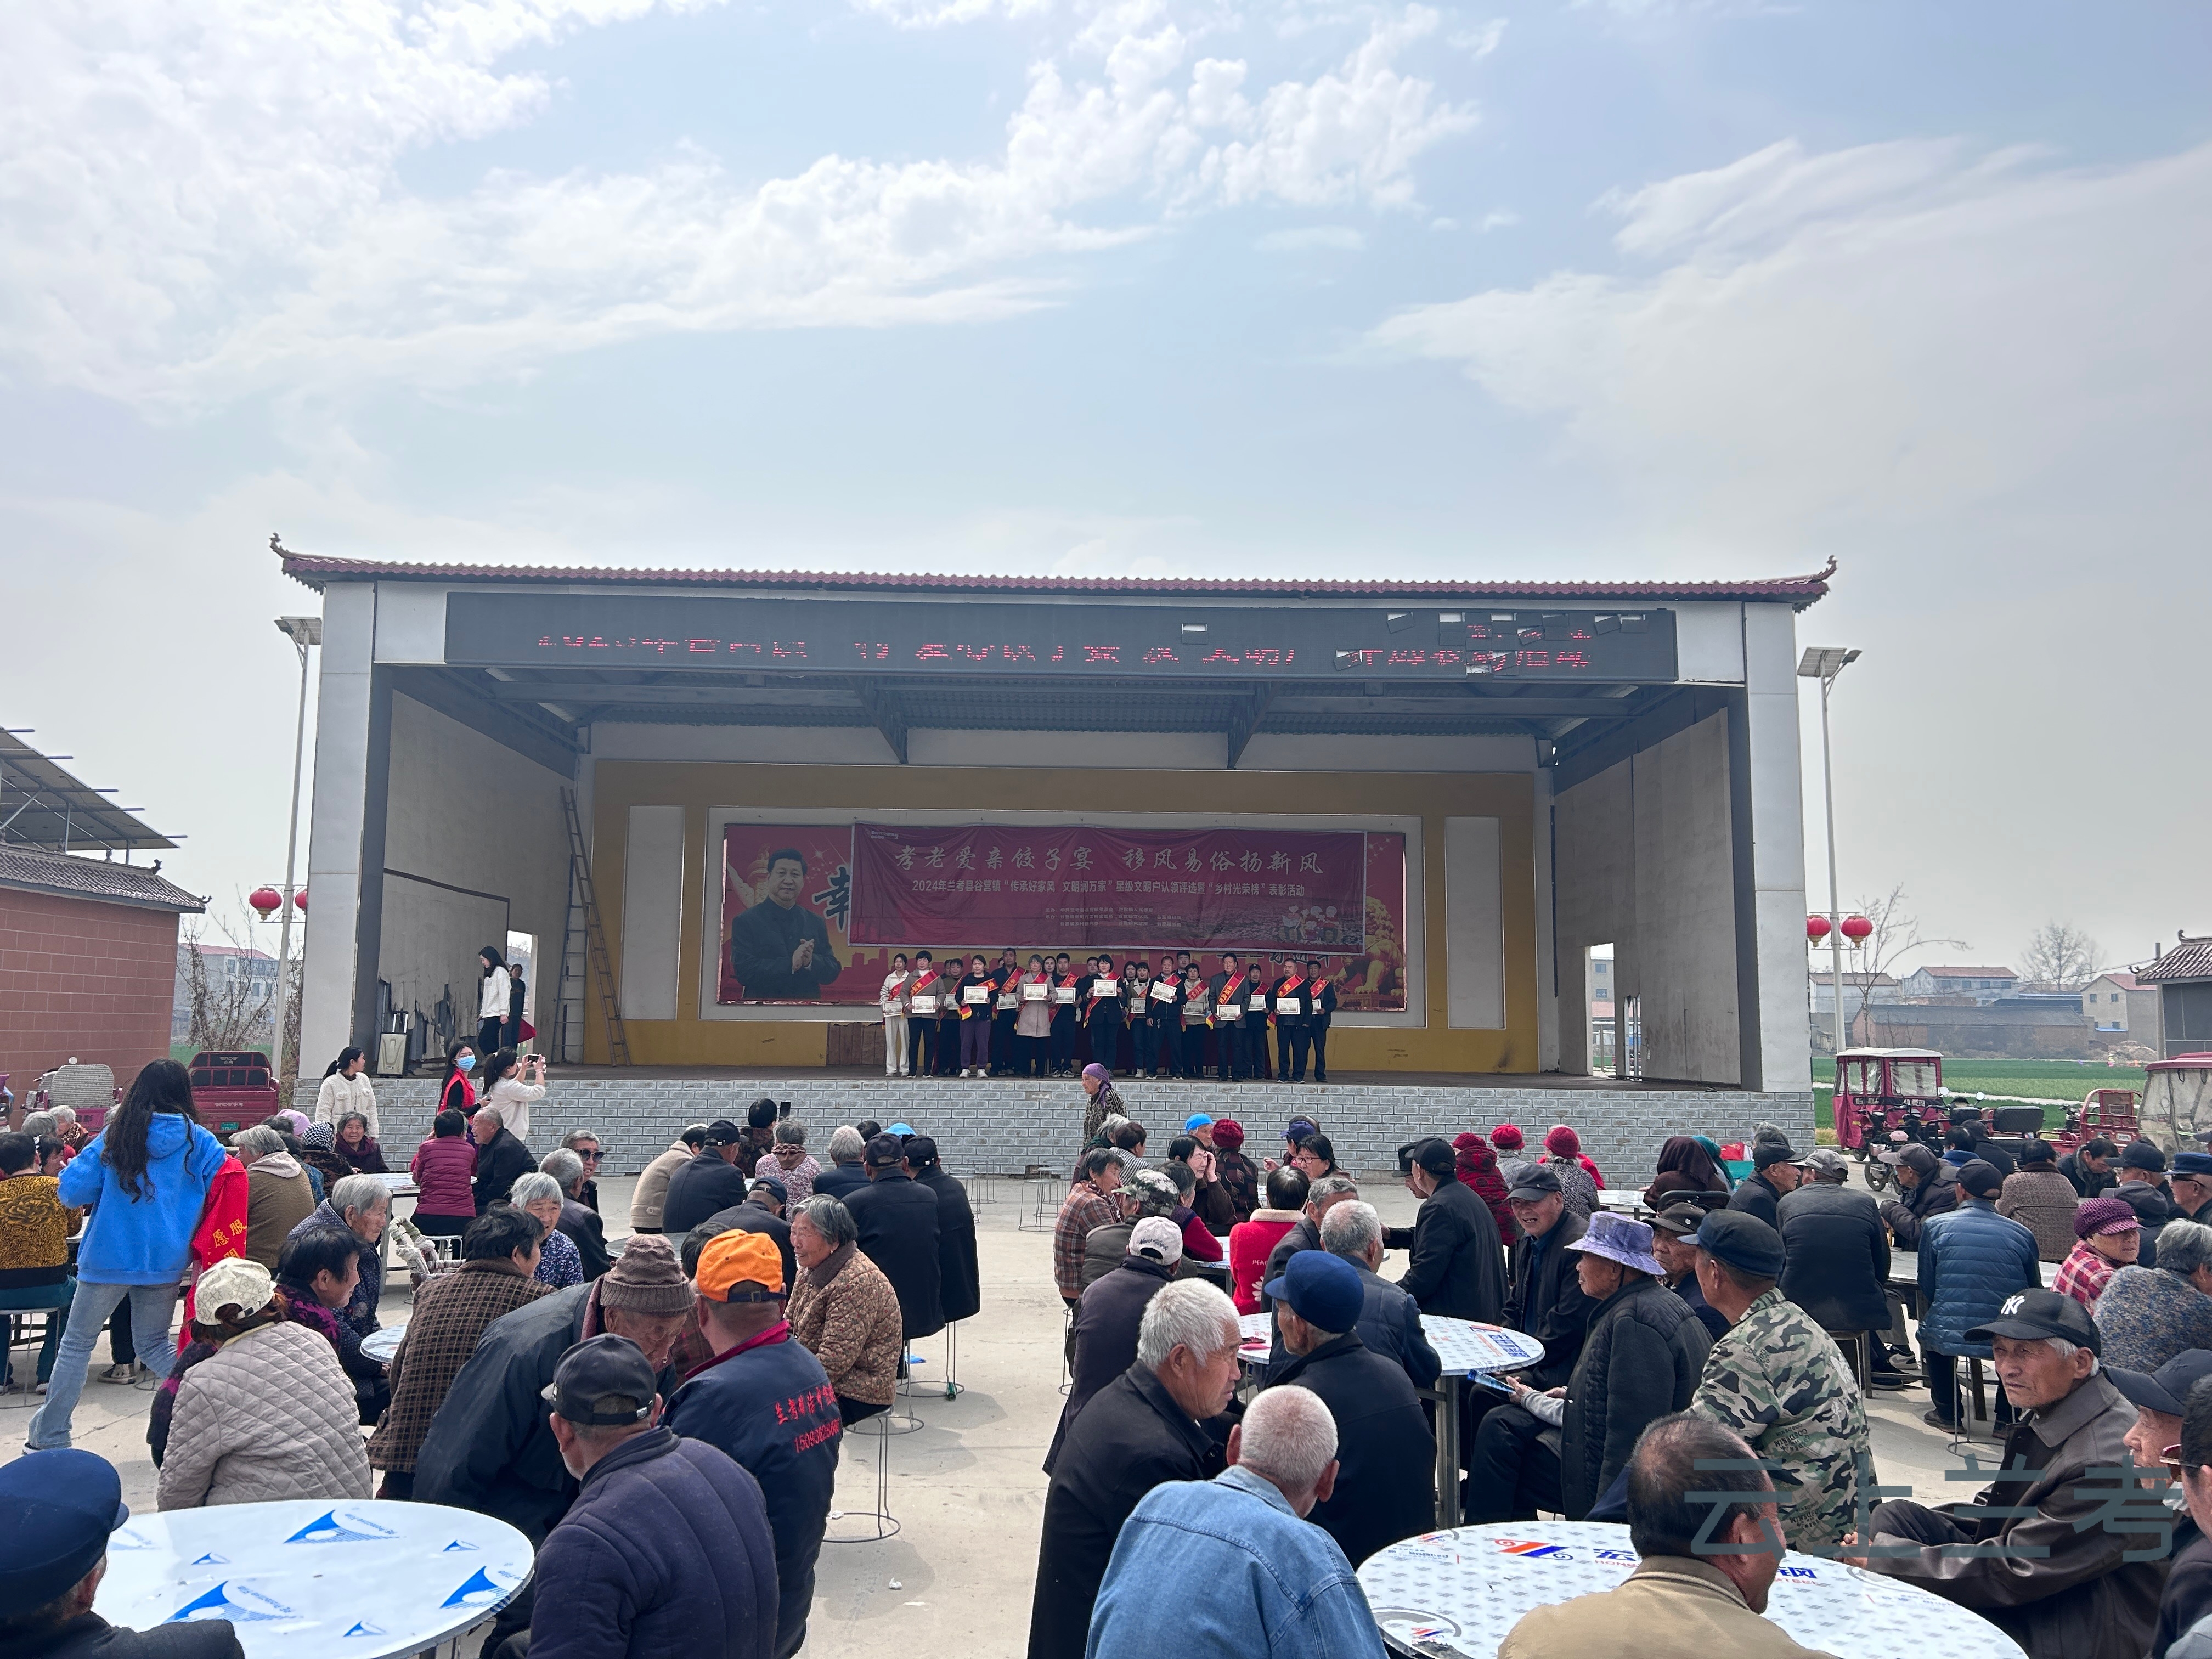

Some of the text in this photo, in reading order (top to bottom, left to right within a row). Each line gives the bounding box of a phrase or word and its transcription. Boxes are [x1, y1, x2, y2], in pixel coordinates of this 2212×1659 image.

[894, 844, 1324, 876] 孝老爱亲饺子宴 移风易俗扬新风
[912, 879, 1055, 893] 2024年兰考县谷营镇“传承好家风
[212, 1218, 247, 1250] 愿服
[2000, 1295, 2025, 1315] NY
